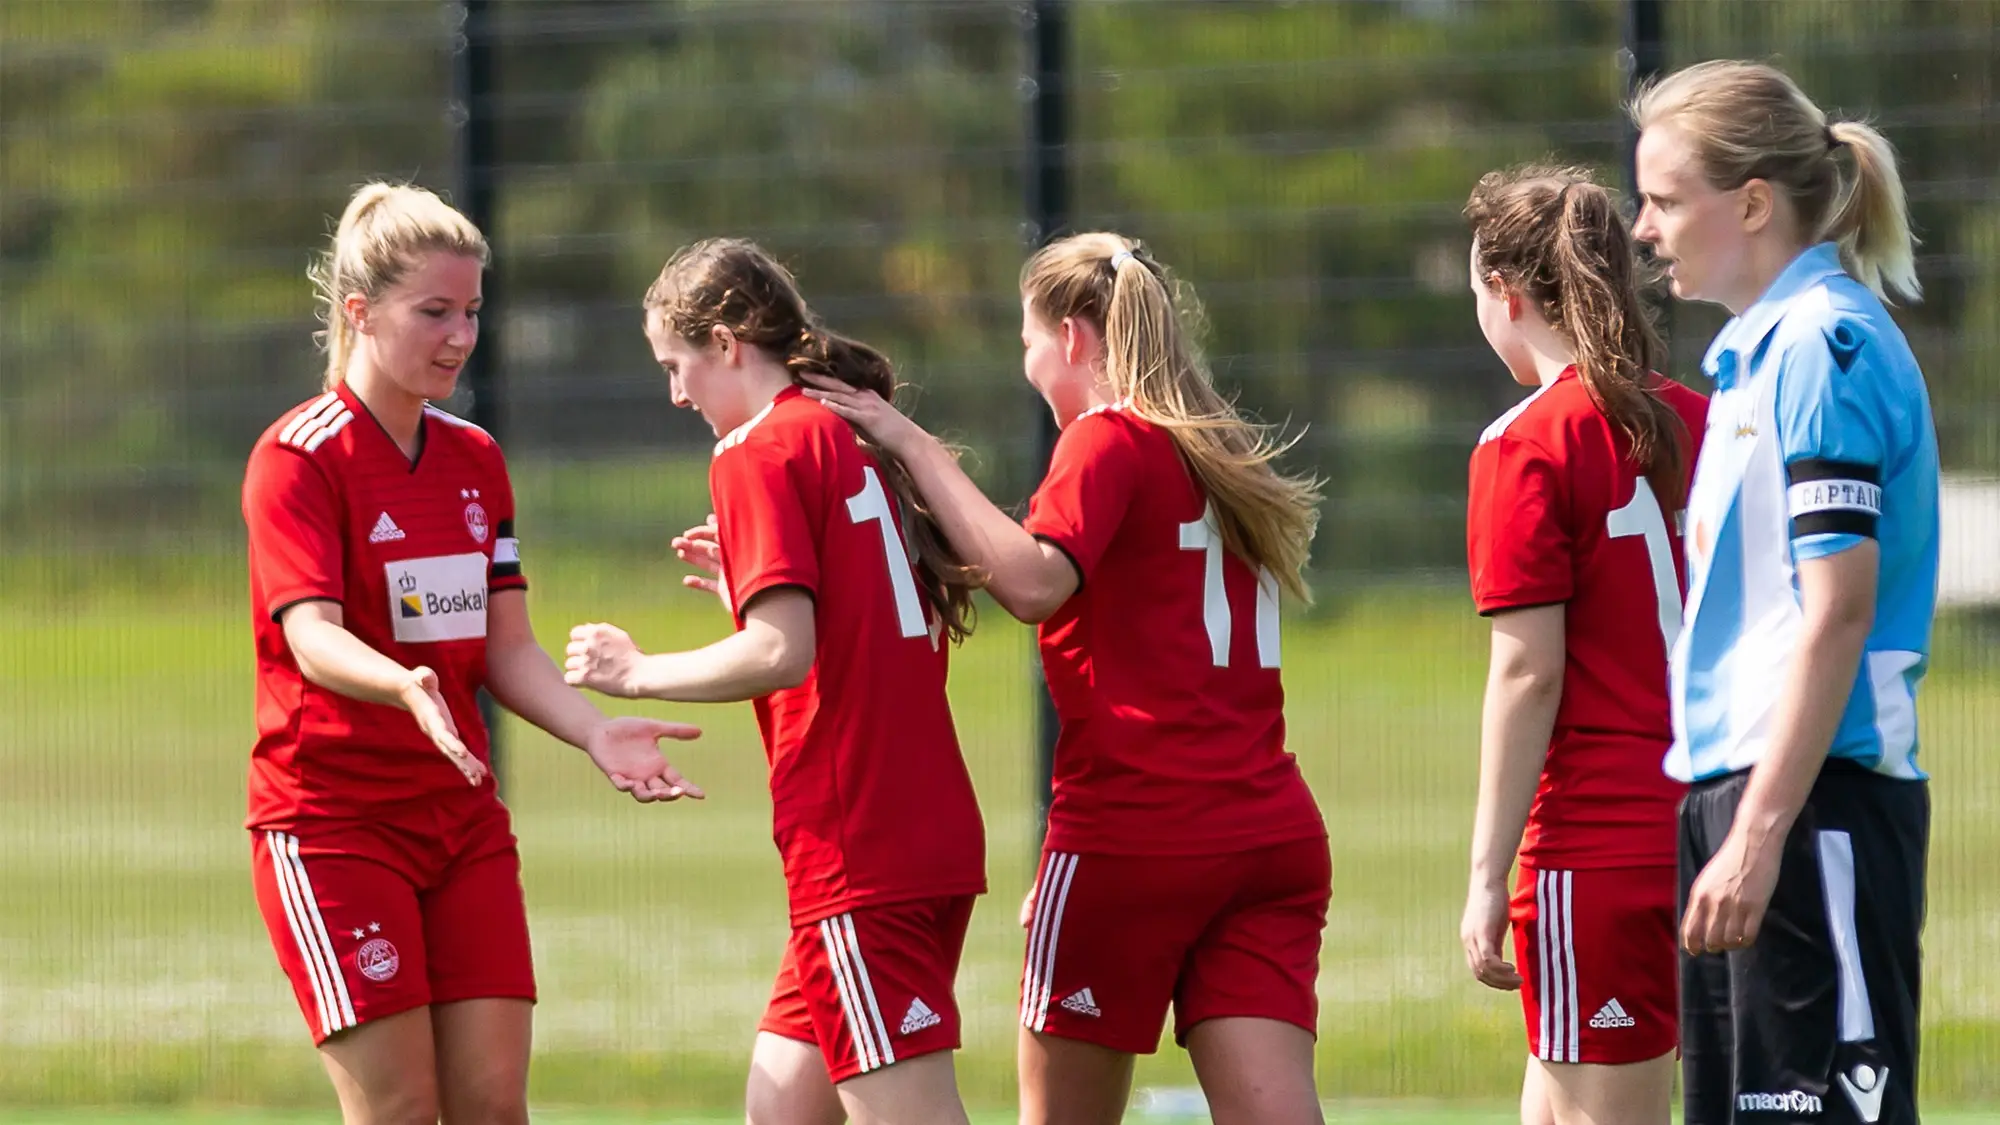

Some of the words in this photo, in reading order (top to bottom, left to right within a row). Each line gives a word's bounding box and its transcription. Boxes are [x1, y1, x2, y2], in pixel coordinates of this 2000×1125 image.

[846, 466, 940, 653] 1
[1607, 476, 1686, 662] 1
[1060, 999, 1101, 1017] adidas
[900, 1013, 941, 1035] adidas
[1589, 1016, 1635, 1028] adidas
[1738, 1089, 1823, 1113] macron
